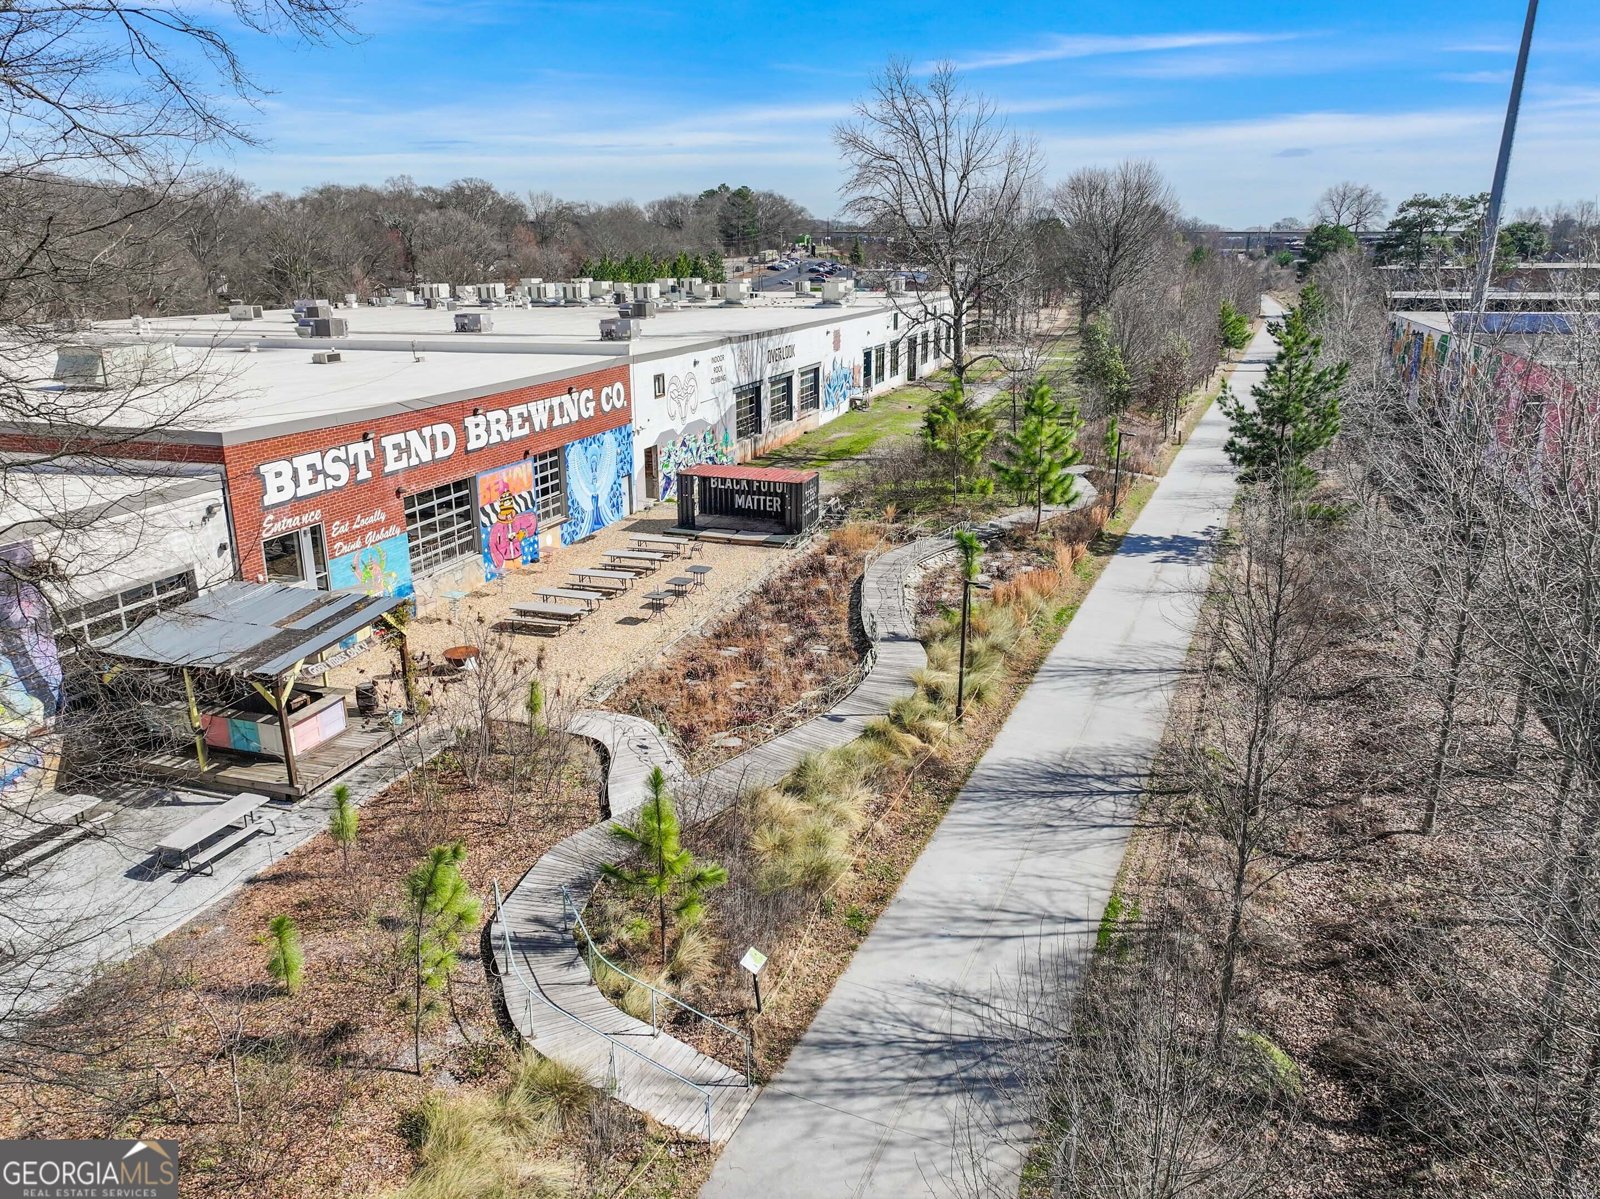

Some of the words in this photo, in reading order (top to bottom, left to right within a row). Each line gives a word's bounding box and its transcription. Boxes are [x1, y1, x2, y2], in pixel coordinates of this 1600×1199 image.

[768, 345, 796, 364] OVERLOOK
[259, 441, 376, 507] BEST
[381, 422, 456, 474] END
[465, 389, 595, 451] BREWING
[600, 381, 627, 413] CO.
[710, 477, 748, 491] BLACK
[735, 494, 781, 512] MATTER
[262, 509, 322, 537] Entrance
[331, 520, 349, 537] Eat
[353, 508, 387, 529] Locally
[334, 537, 362, 556] Drink
[365, 525, 400, 547] Globally
